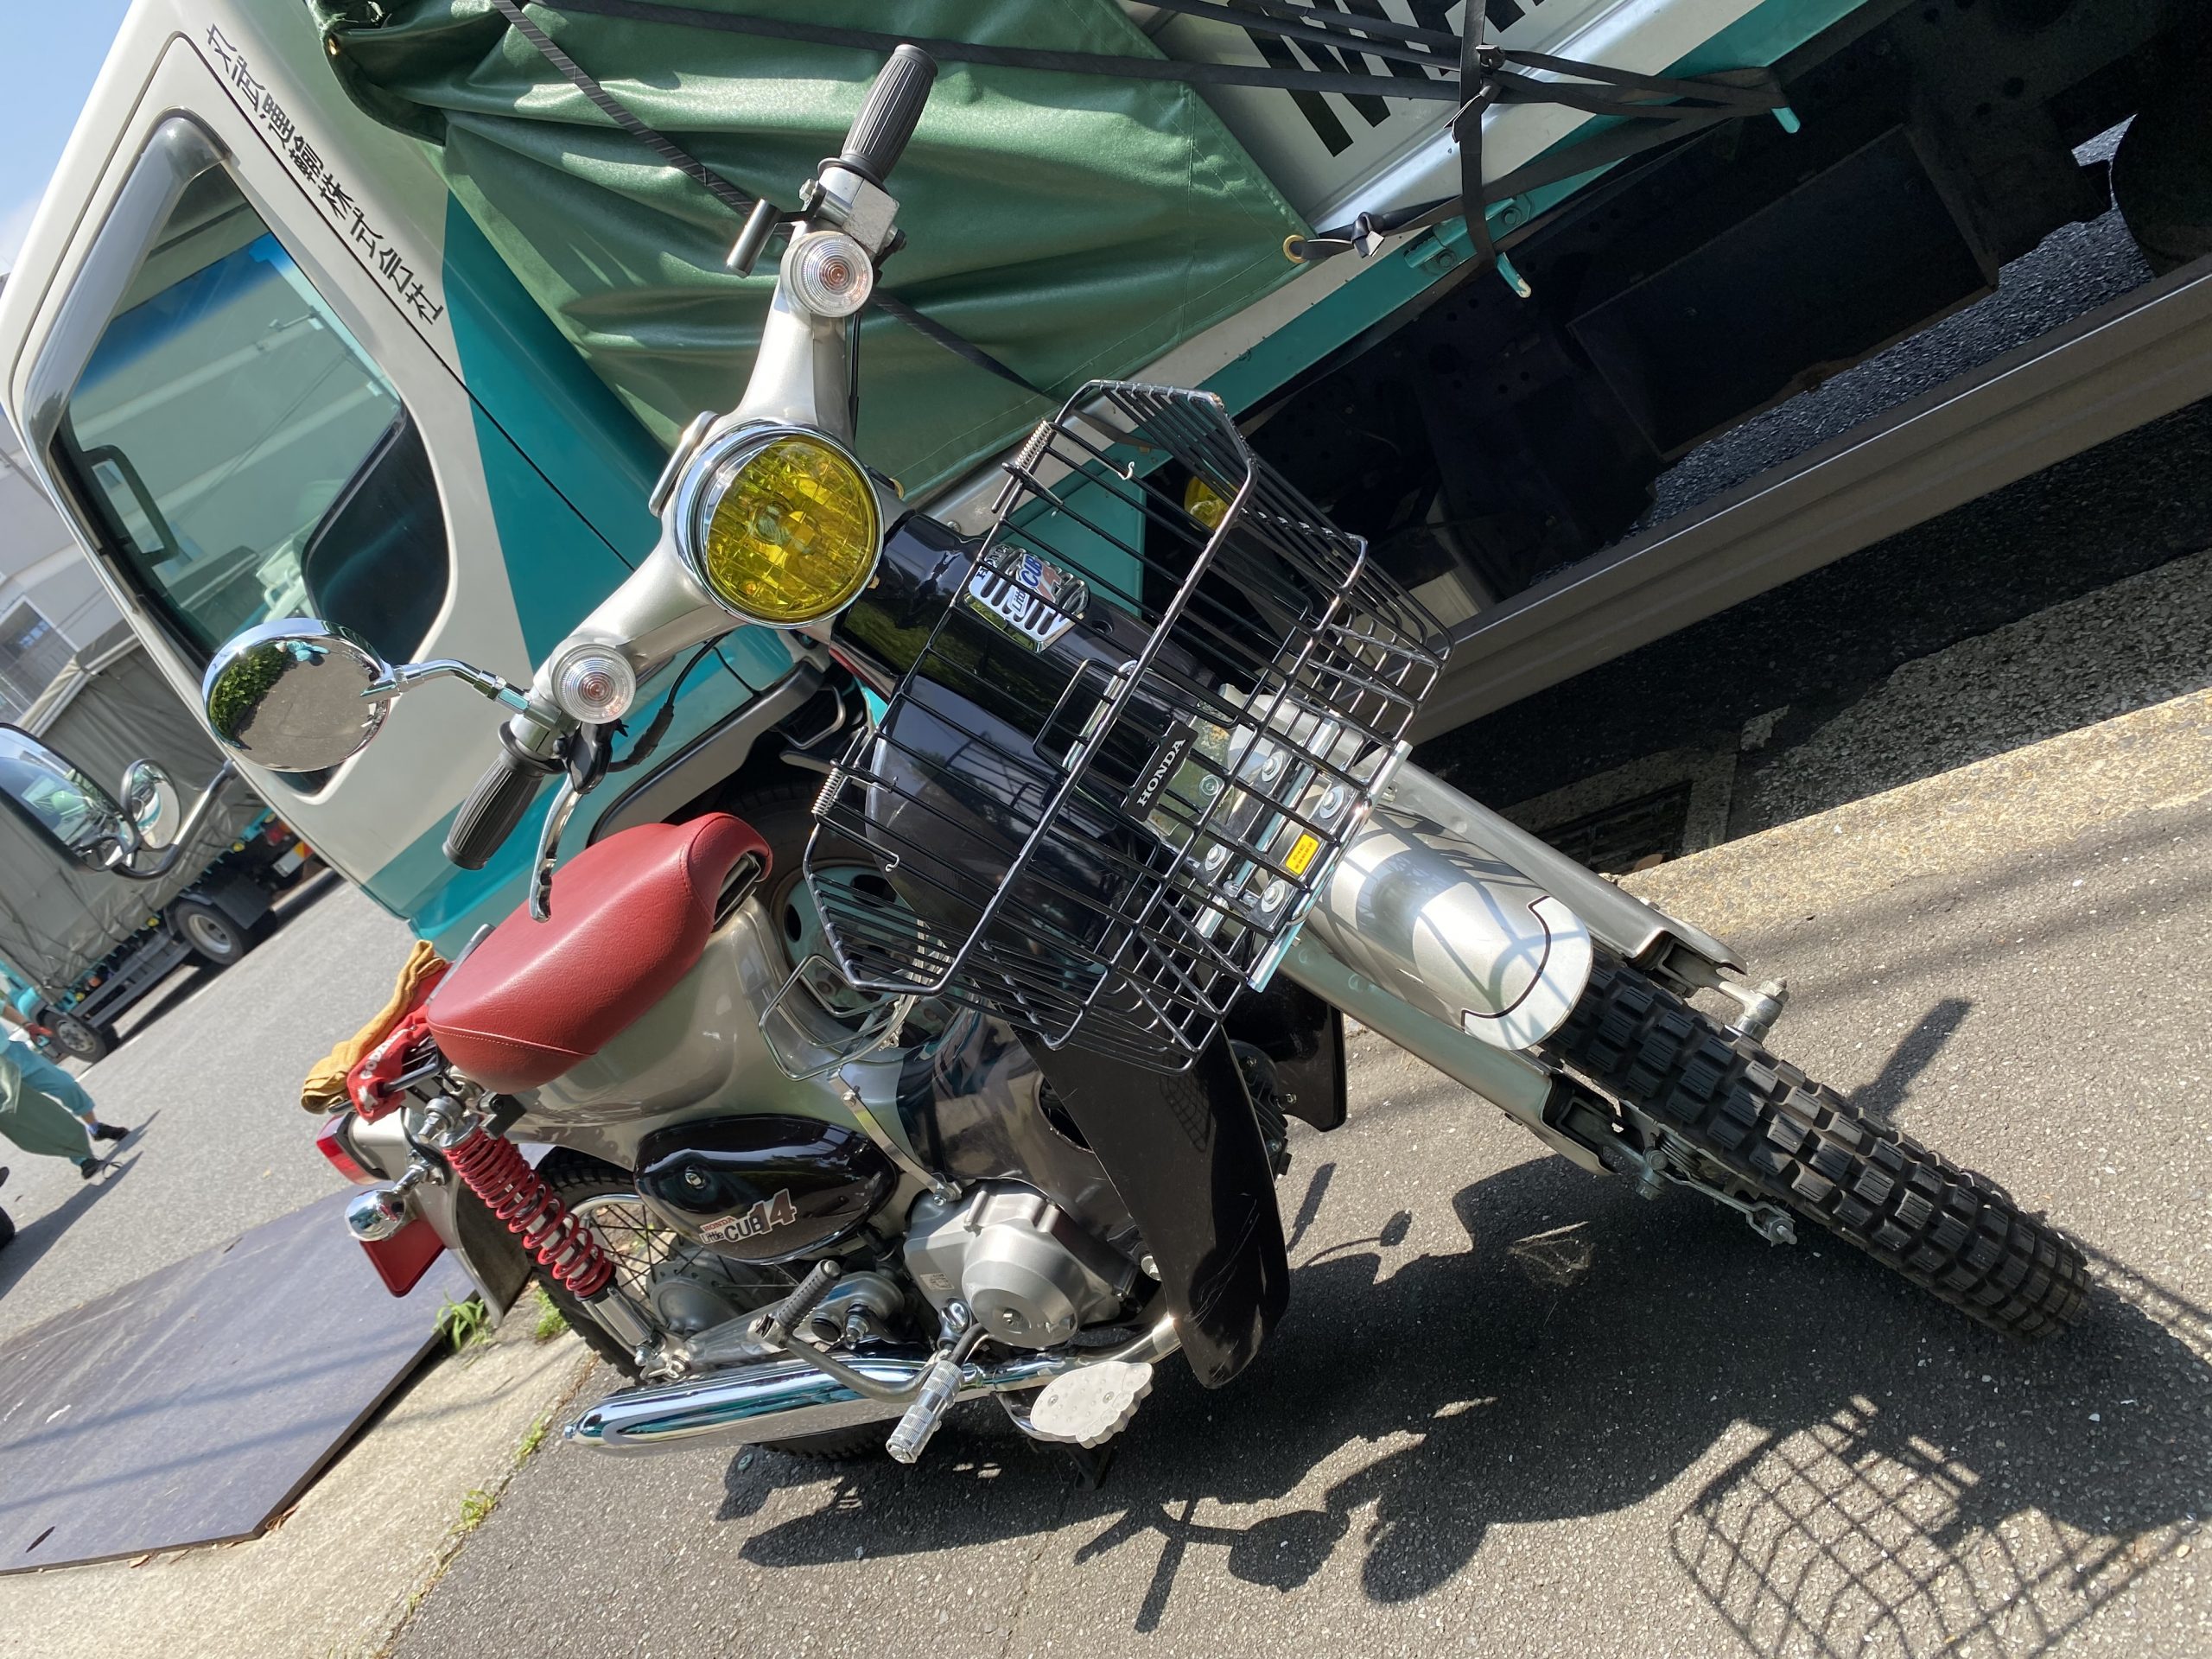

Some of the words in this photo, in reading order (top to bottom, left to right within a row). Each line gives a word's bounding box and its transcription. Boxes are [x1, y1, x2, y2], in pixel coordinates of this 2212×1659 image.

[207, 24, 443, 325] 丸武運輸株式会社
[1021, 553, 1043, 587] CUB
[1136, 739, 1186, 807] HONDA
[701, 1230, 726, 1243] Little
[724, 1213, 764, 1242] CUB
[748, 1190, 796, 1234] 14
[703, 1217, 734, 1232] HONDA
